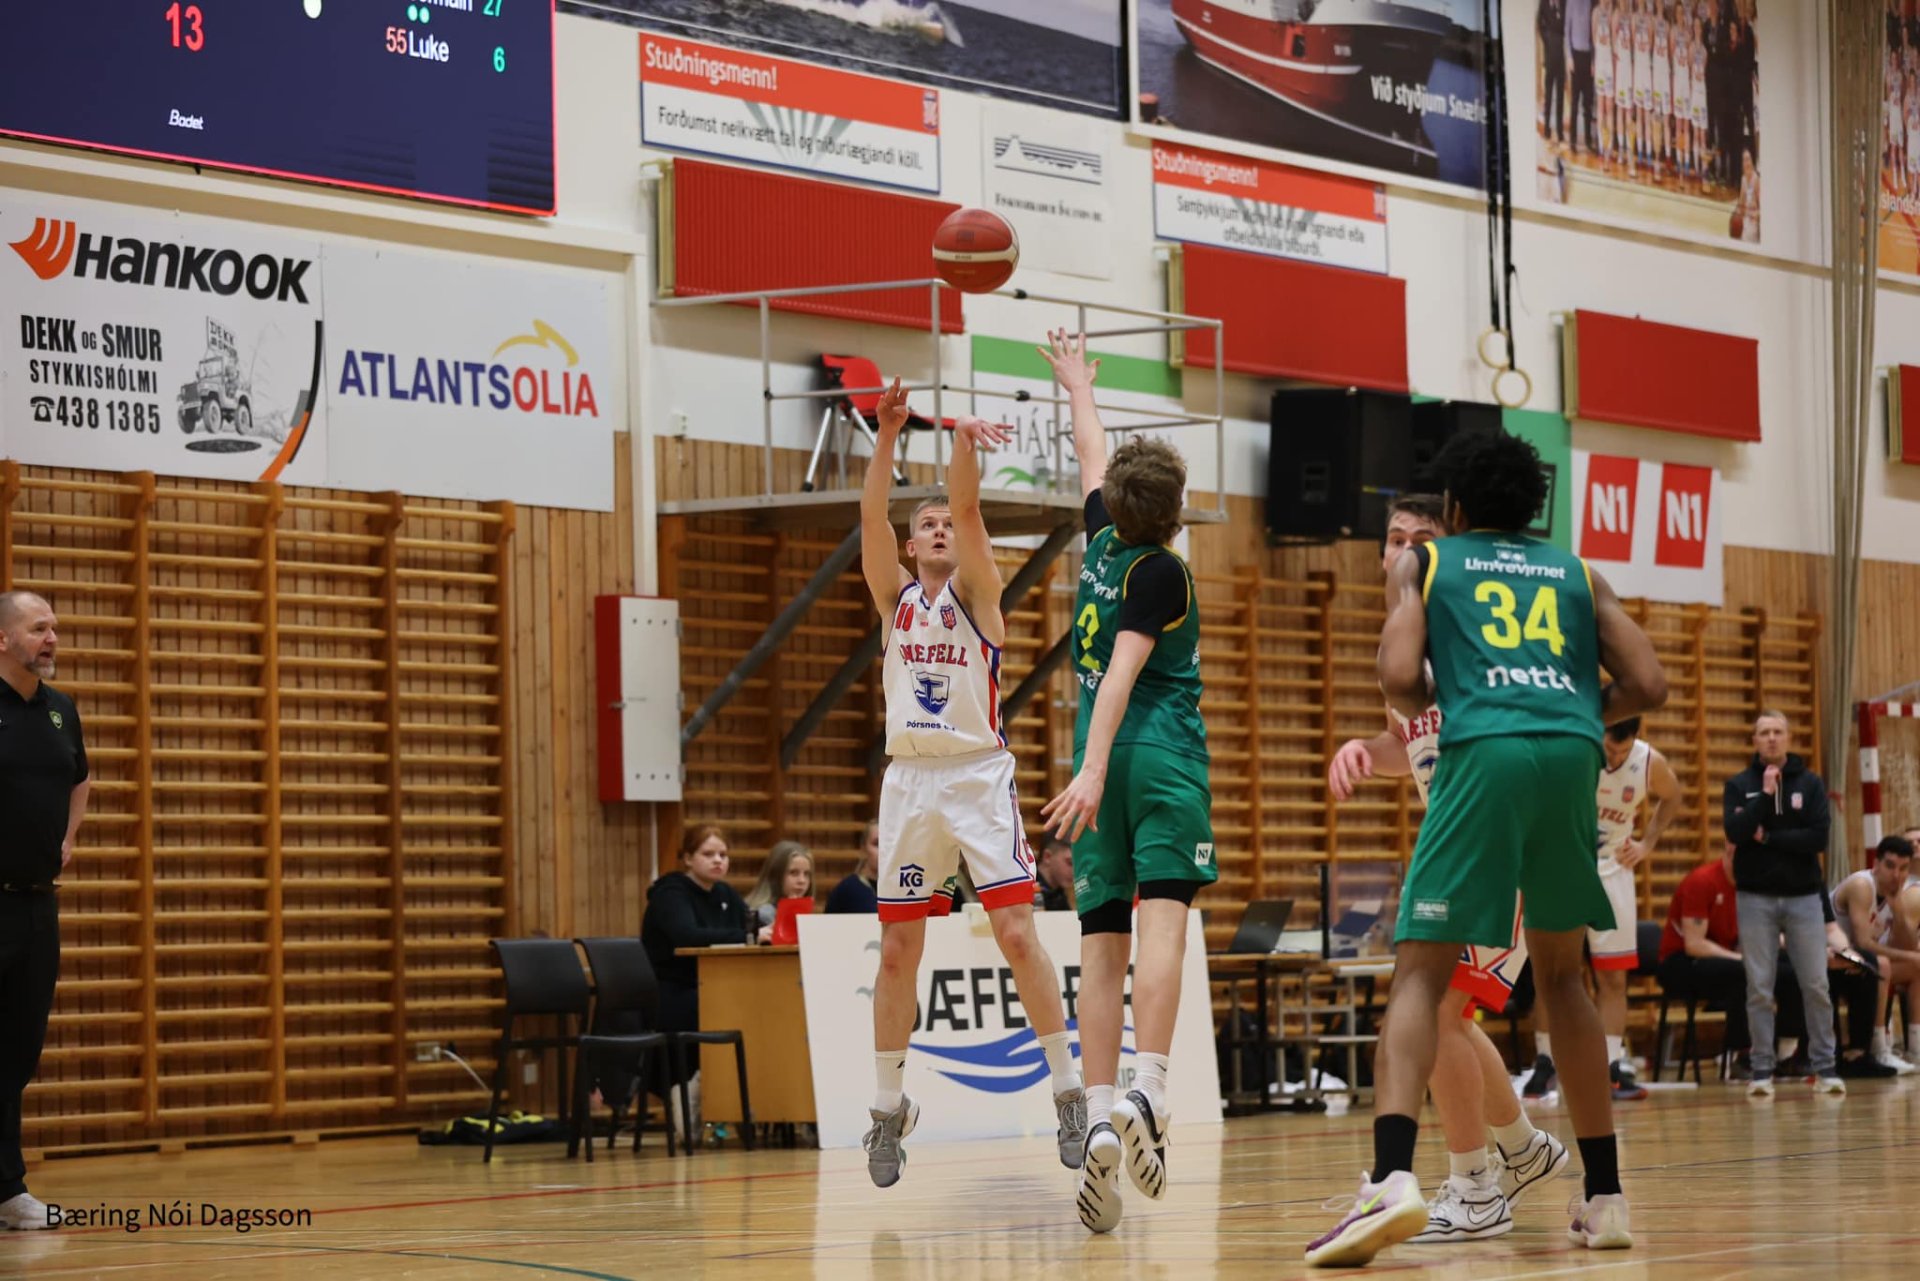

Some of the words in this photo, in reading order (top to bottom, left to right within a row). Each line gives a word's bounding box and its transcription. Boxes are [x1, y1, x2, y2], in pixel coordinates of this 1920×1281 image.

[165, 2, 204, 51] 13
[385, 26, 408, 55] 55
[408, 29, 450, 62] Luke
[493, 46, 506, 73] 6
[645, 42, 777, 90] Stuðningsmenn!
[1370, 75, 1393, 102] Við
[1395, 83, 1446, 116] styðjum
[168, 109, 204, 130] Bodet
[658, 105, 718, 134] Forðumst
[779, 130, 796, 147] tal
[20, 314, 77, 354] DEKK
[82, 331, 97, 350] OG
[102, 323, 163, 362] SMUR
[29, 358, 158, 394] STYKKISHÓLMI
[56, 395, 99, 429] 438
[105, 400, 161, 434] 1385
[1591, 482, 1629, 535] N1
[1665, 490, 1703, 543] N1
[1474, 580, 1566, 657] 34
[1197, 848, 1209, 860] N1
[900, 872, 923, 888] KG
